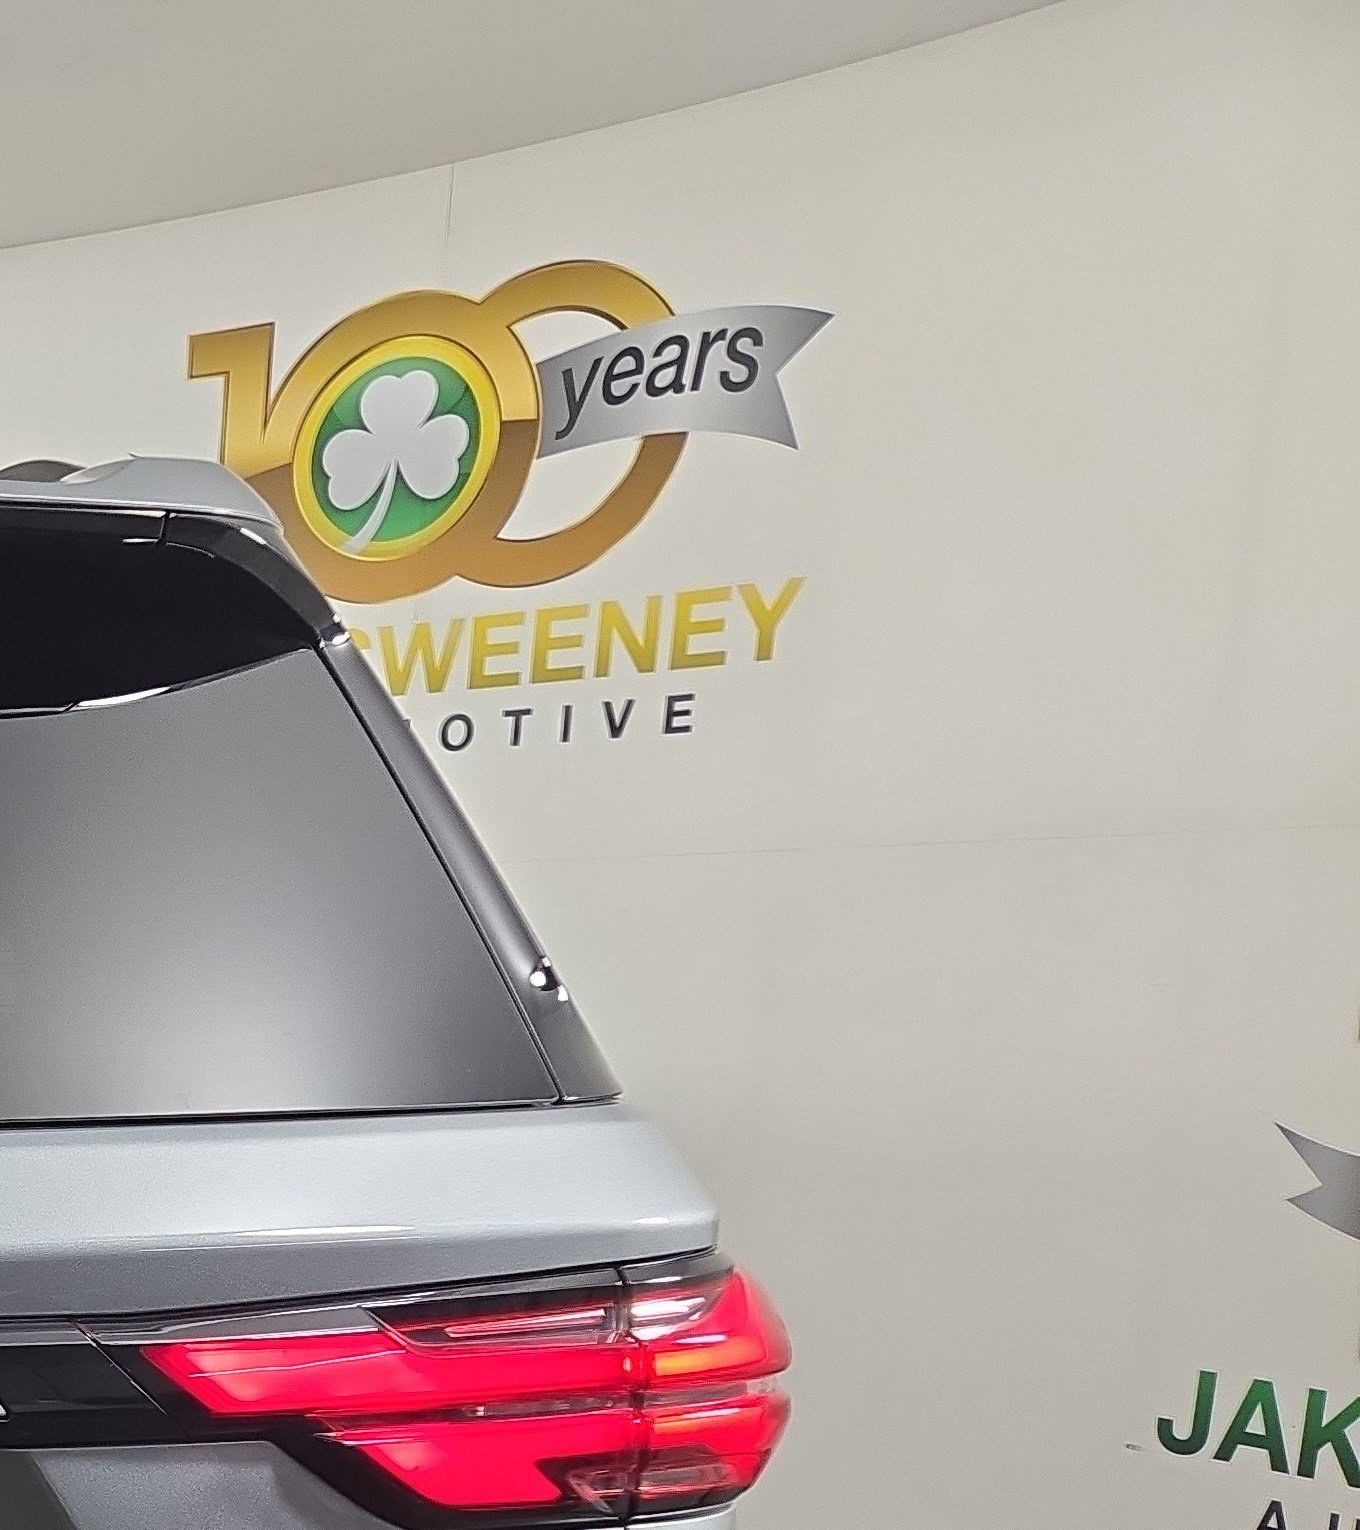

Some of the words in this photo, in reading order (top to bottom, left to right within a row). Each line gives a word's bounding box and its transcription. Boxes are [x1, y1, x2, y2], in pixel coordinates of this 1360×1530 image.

[553, 325, 764, 440] years
[349, 577, 806, 696] WEENEY
[402, 694, 696, 752] OTIVE
